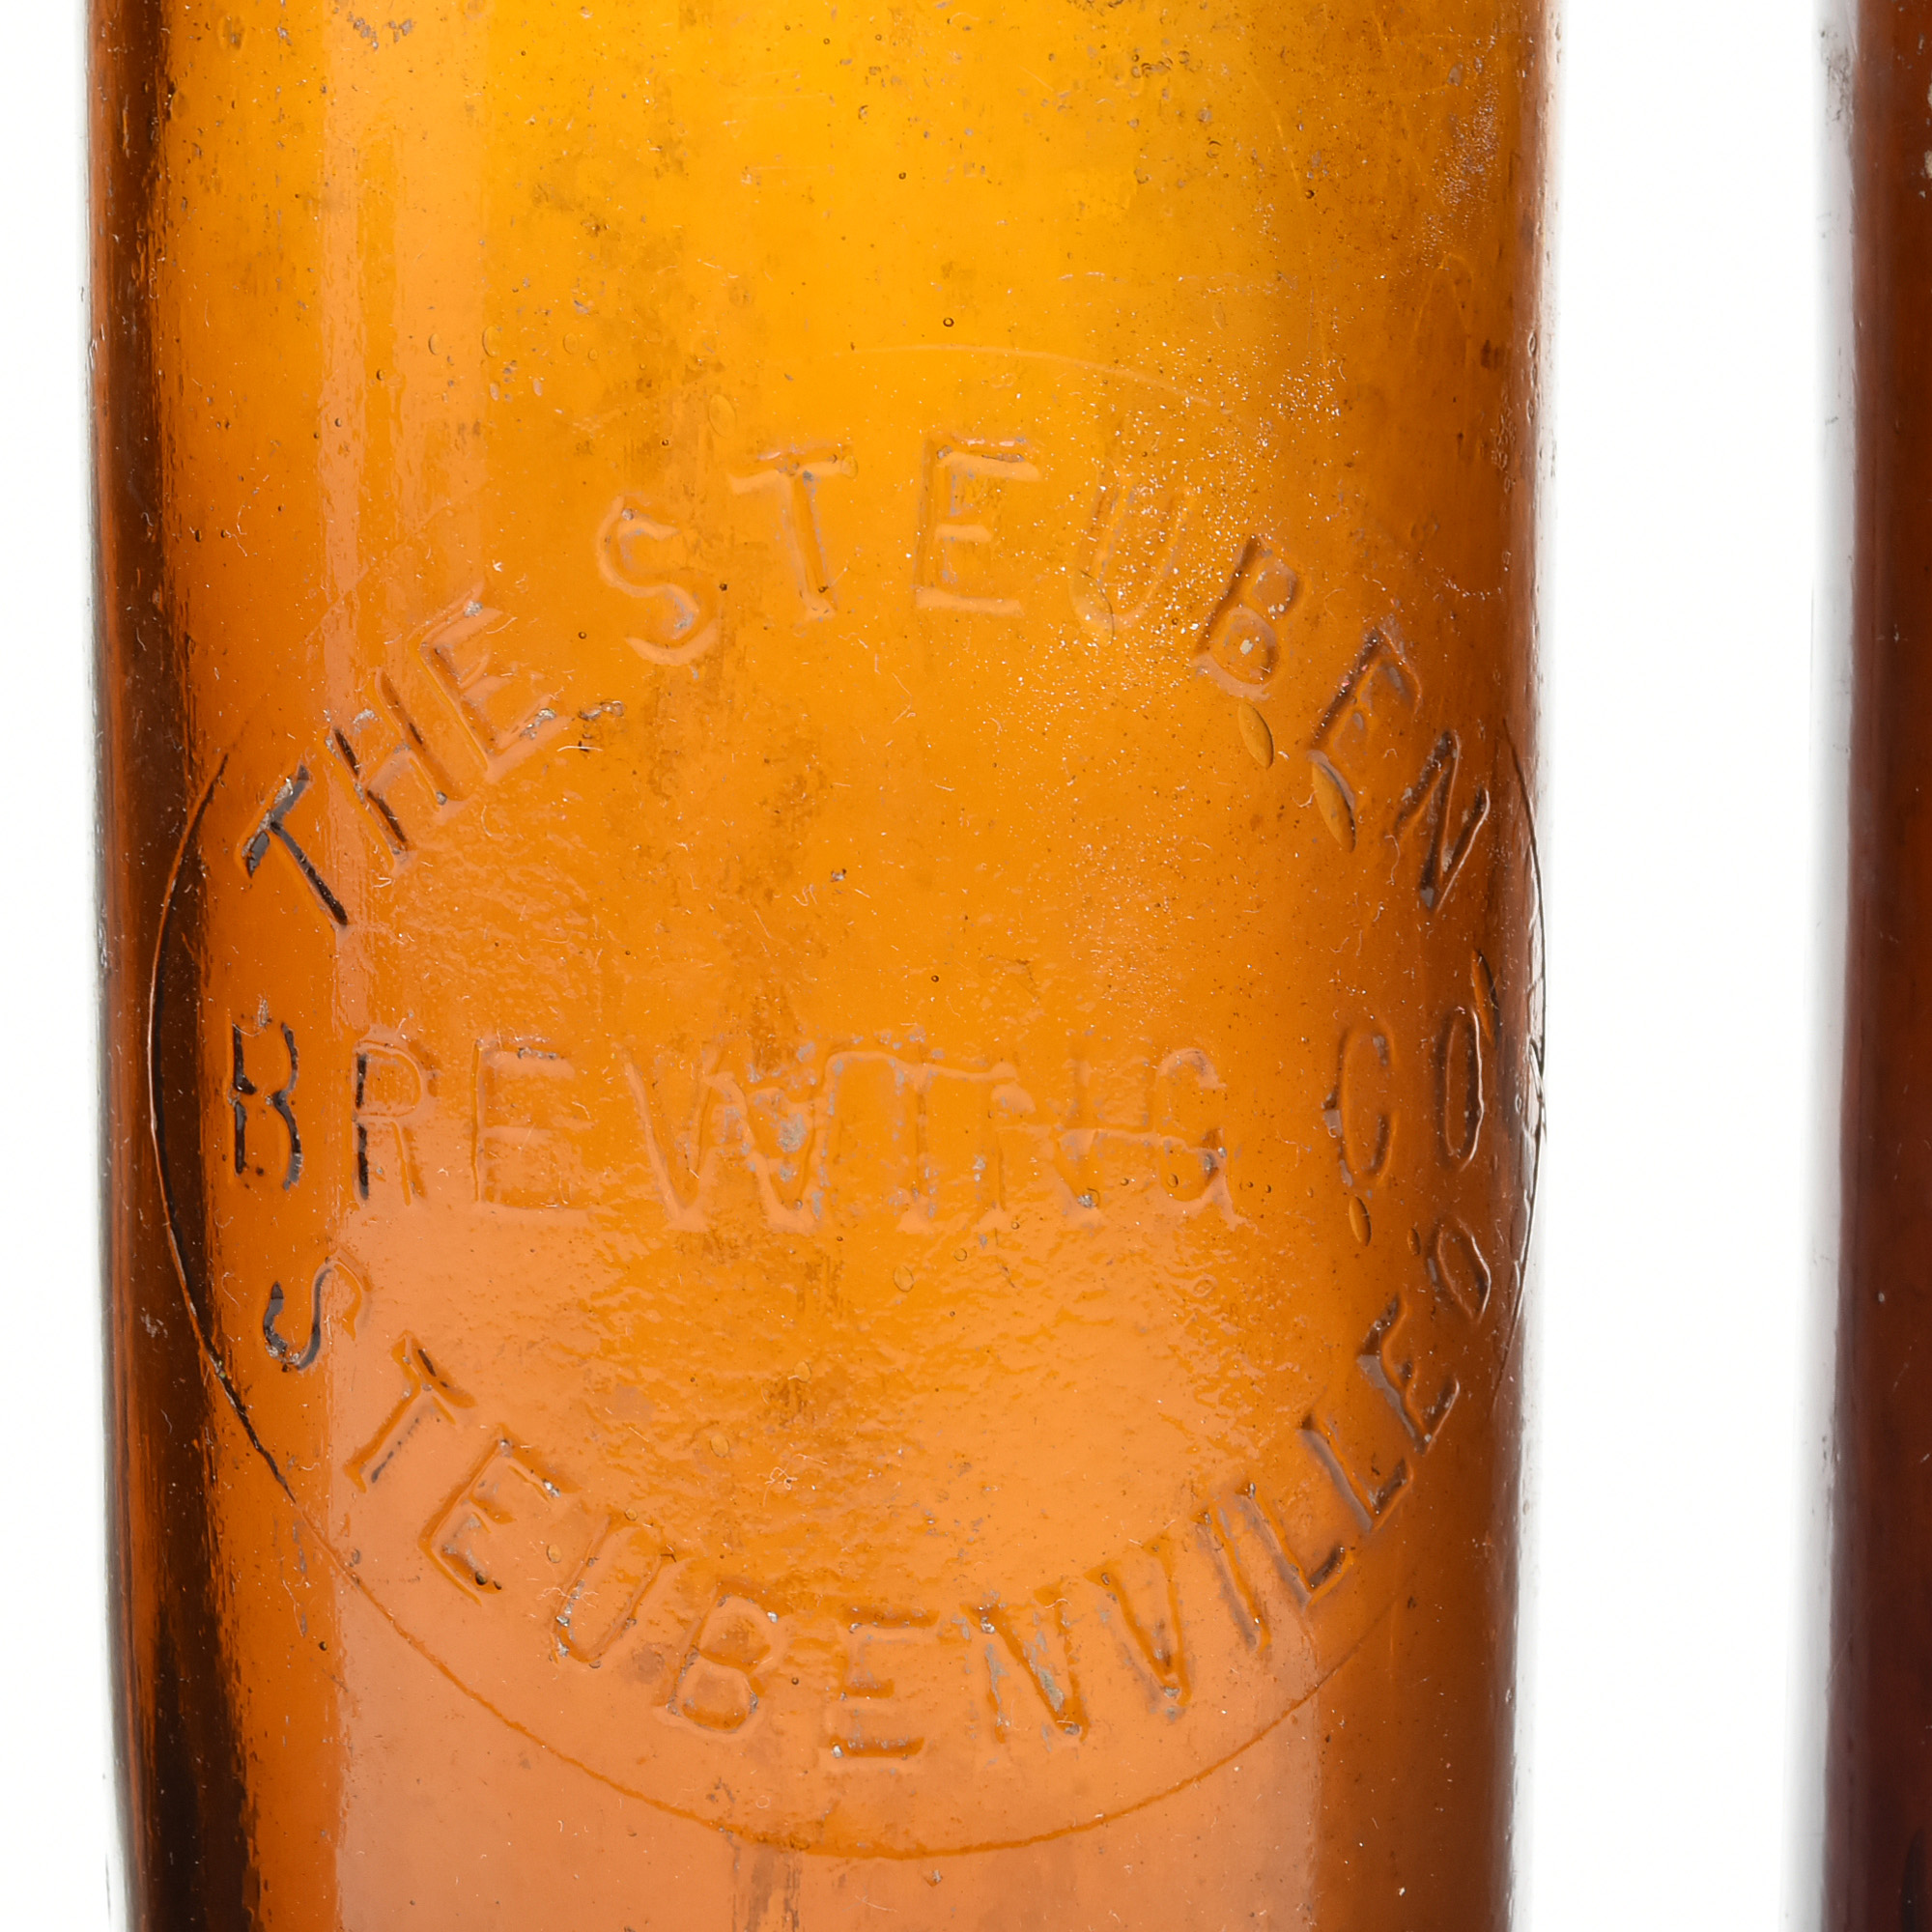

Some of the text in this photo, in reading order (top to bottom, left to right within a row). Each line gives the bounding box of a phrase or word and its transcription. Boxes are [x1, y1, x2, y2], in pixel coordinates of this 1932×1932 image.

[235, 437, 1492, 937] THE STEUBEN
[227, 1016, 1241, 1234] BREWING
[264, 1254, 1461, 1779] STEUBENVILLE
